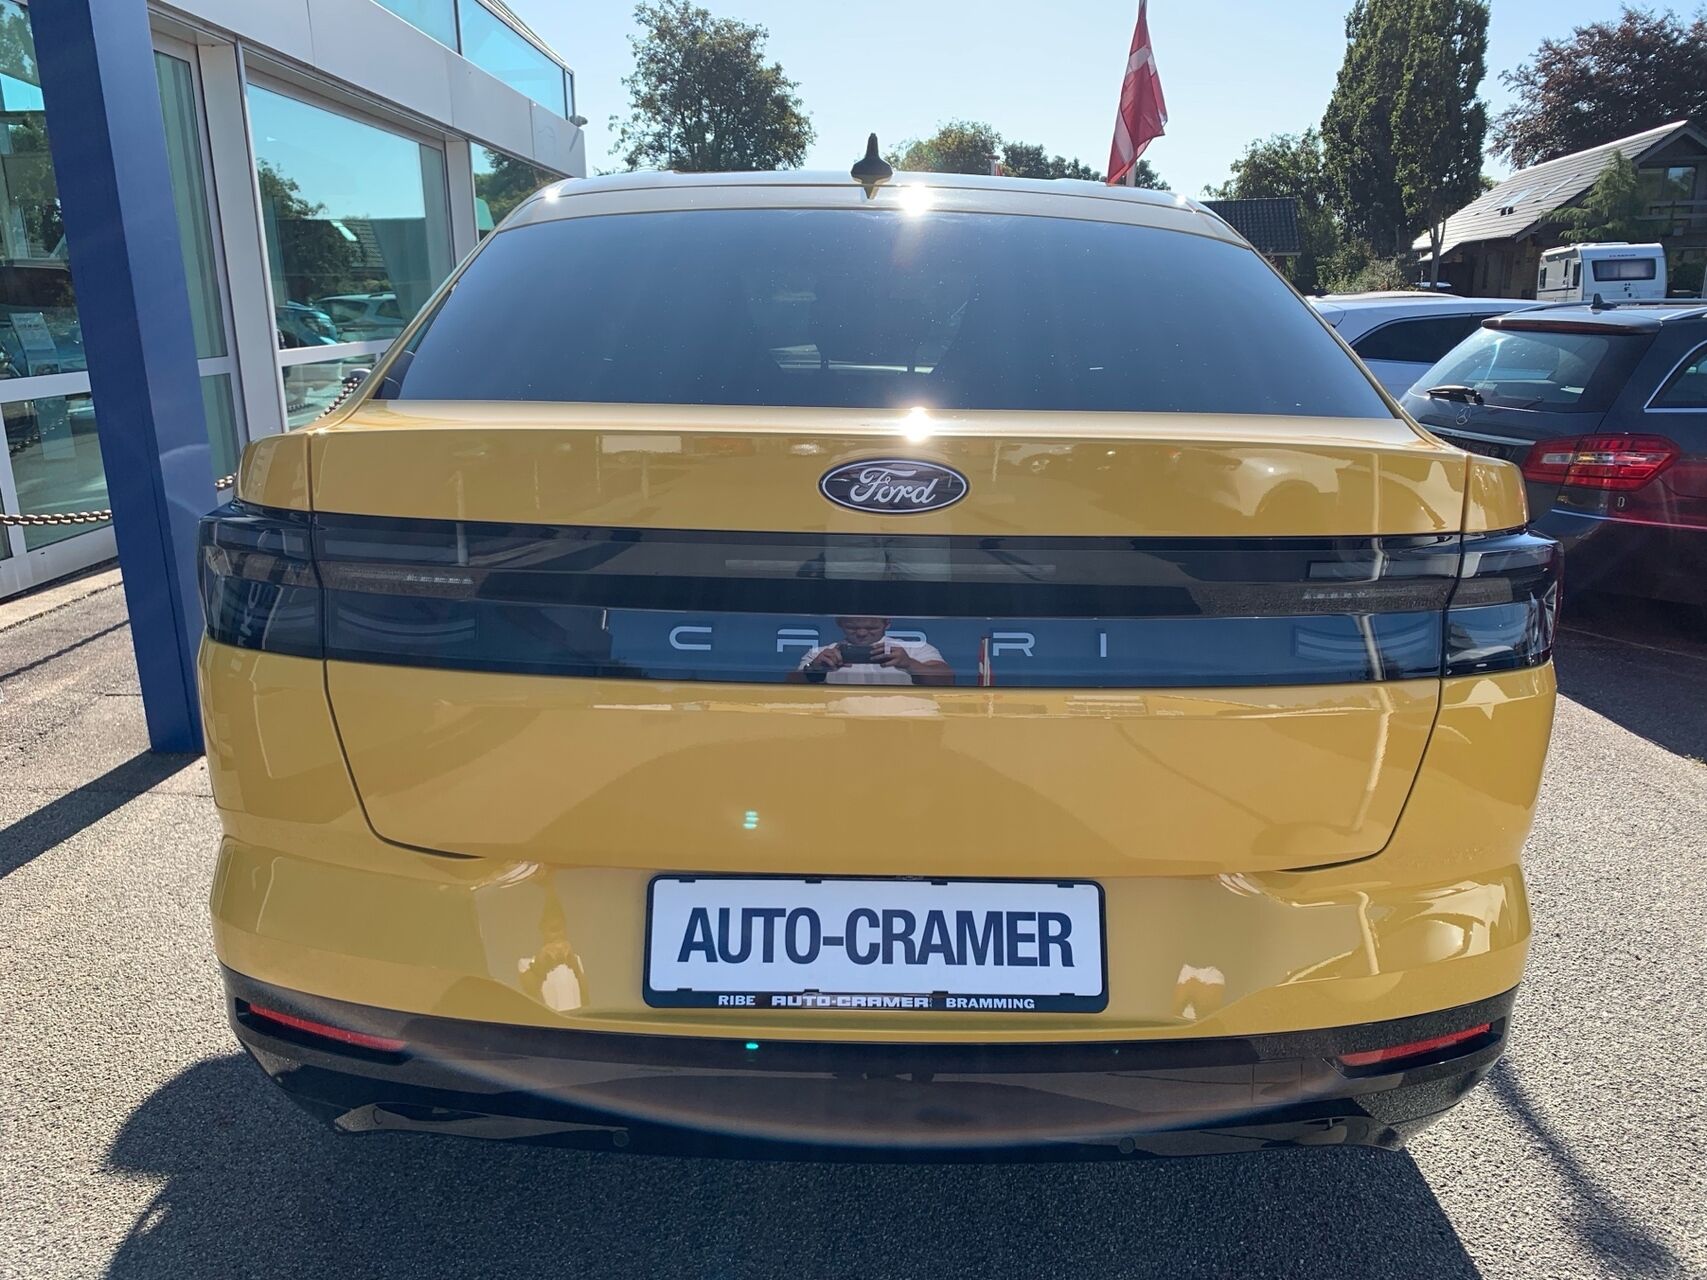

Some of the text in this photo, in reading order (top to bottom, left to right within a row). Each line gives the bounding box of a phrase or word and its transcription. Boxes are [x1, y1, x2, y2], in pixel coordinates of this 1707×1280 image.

[850, 467, 939, 504] Ford
[669, 625, 1107, 658] CAPRI
[677, 906, 1075, 968] AUTO-CRAMER
[718, 994, 1036, 1010] RIBE AUTO-CRAMER BRAMMING
